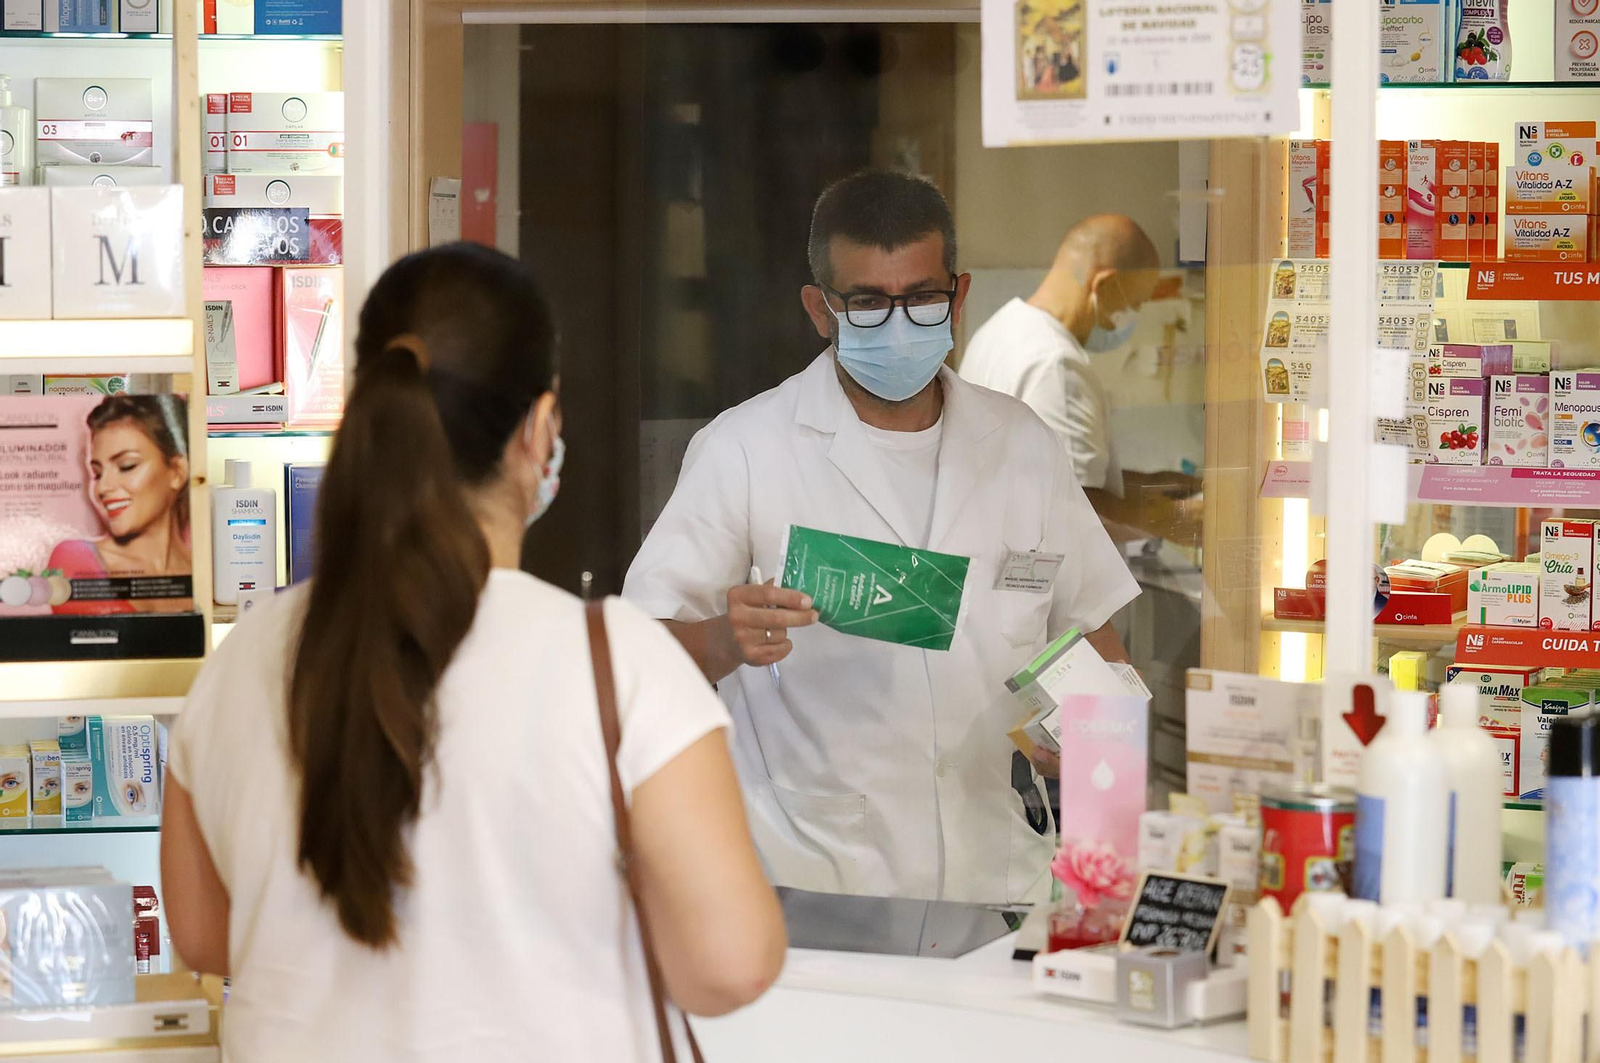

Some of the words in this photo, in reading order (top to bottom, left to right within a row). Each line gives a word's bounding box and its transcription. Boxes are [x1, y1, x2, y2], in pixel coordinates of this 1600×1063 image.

[1306, 24, 1329, 34] less
[42, 124, 57, 135] 03
[210, 136, 225, 147] 01
[234, 135, 248, 146] 01
[1515, 170, 1549, 180] Vitans
[1517, 181, 1552, 189] Vitalidad
[1555, 180, 1572, 189] A-Z
[1514, 219, 1547, 229] Vitans
[1515, 229, 1550, 237] Vitalidad
[1552, 228, 1570, 237] A-Z
[94, 234, 145, 286] M
[1554, 272, 1583, 284] TUS
[1428, 406, 1469, 418] Cispren
[1494, 406, 1522, 417] Femi
[1494, 417, 1524, 427] biotic
[23, 470, 59, 479] radiante
[37, 482, 82, 492] maquillaje
[1545, 560, 1574, 574] Chía
[854, 573, 865, 610] Andalucía
[1481, 583, 1532, 594] ArmoLIPID
[849, 585, 858, 606] cuida
[1507, 594, 1531, 604] PLUS
[1542, 639, 1588, 652] CUIDA
[140, 725, 152, 783] Optispring
